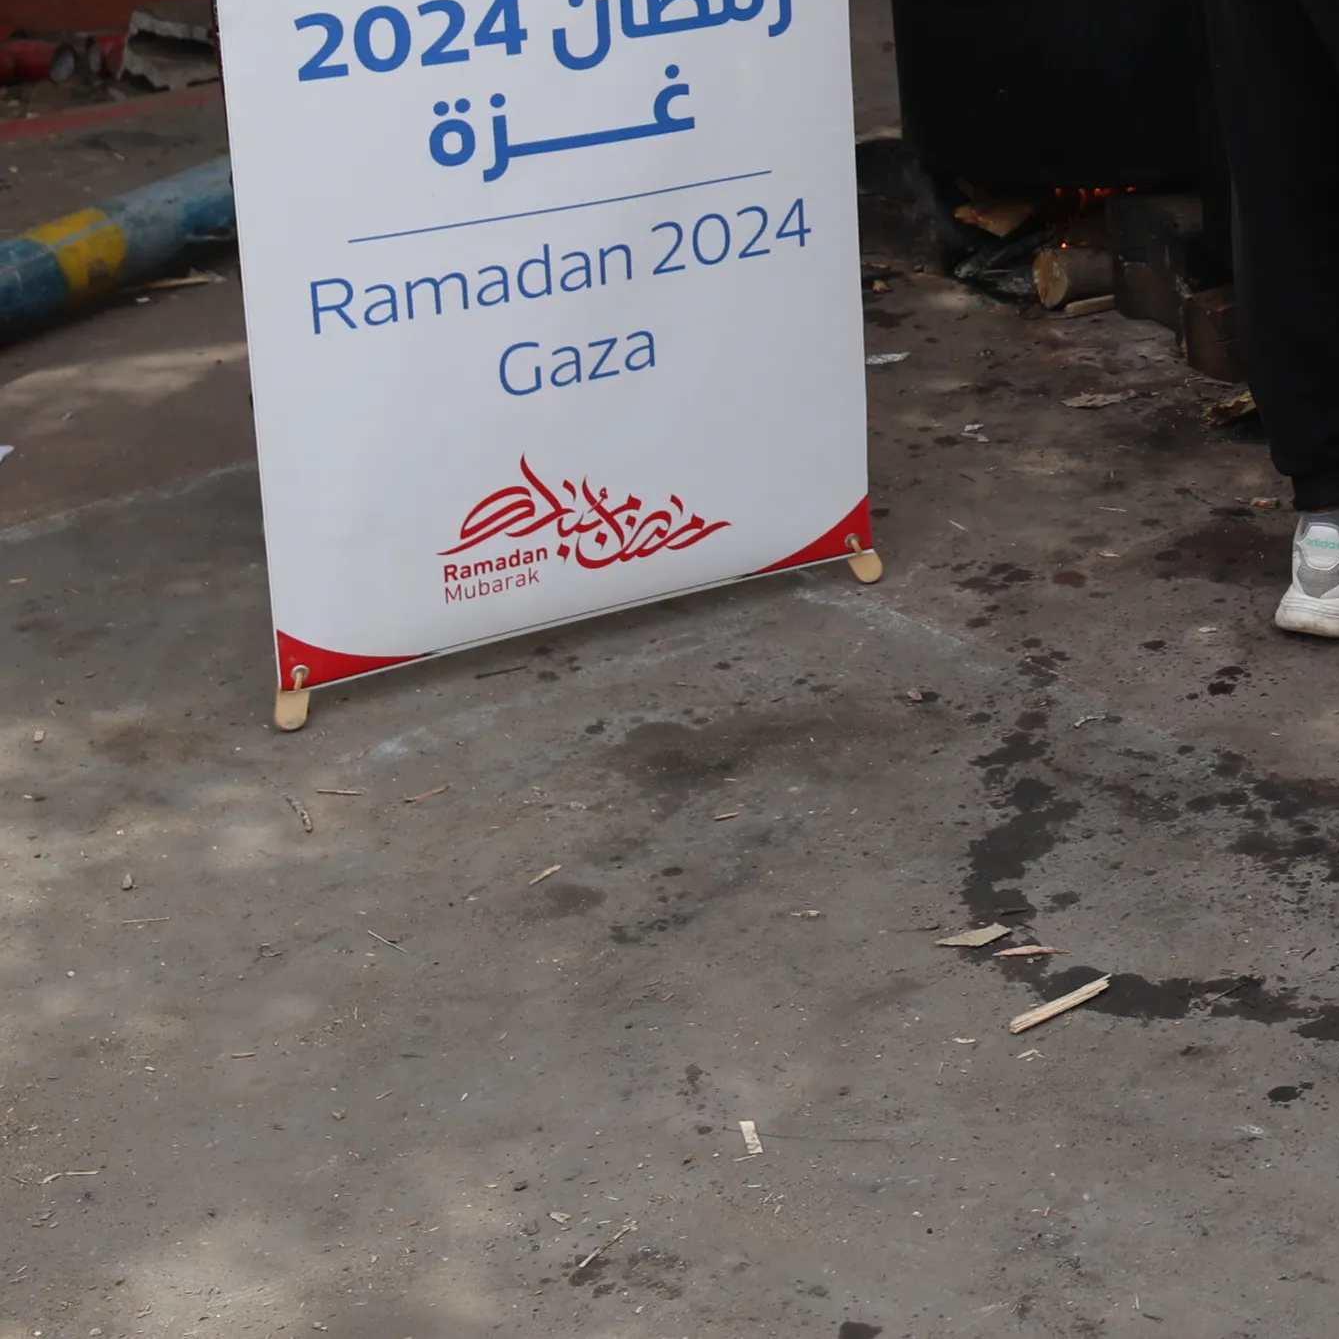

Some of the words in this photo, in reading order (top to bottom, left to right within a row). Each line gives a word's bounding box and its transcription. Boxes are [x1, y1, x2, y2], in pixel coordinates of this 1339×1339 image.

[310, 242, 634, 336] Ramadan
[651, 198, 812, 275] 2024
[499, 330, 657, 396] Gaza
[443, 546, 549, 583] Ramadan
[444, 567, 540, 604] Mubarak
